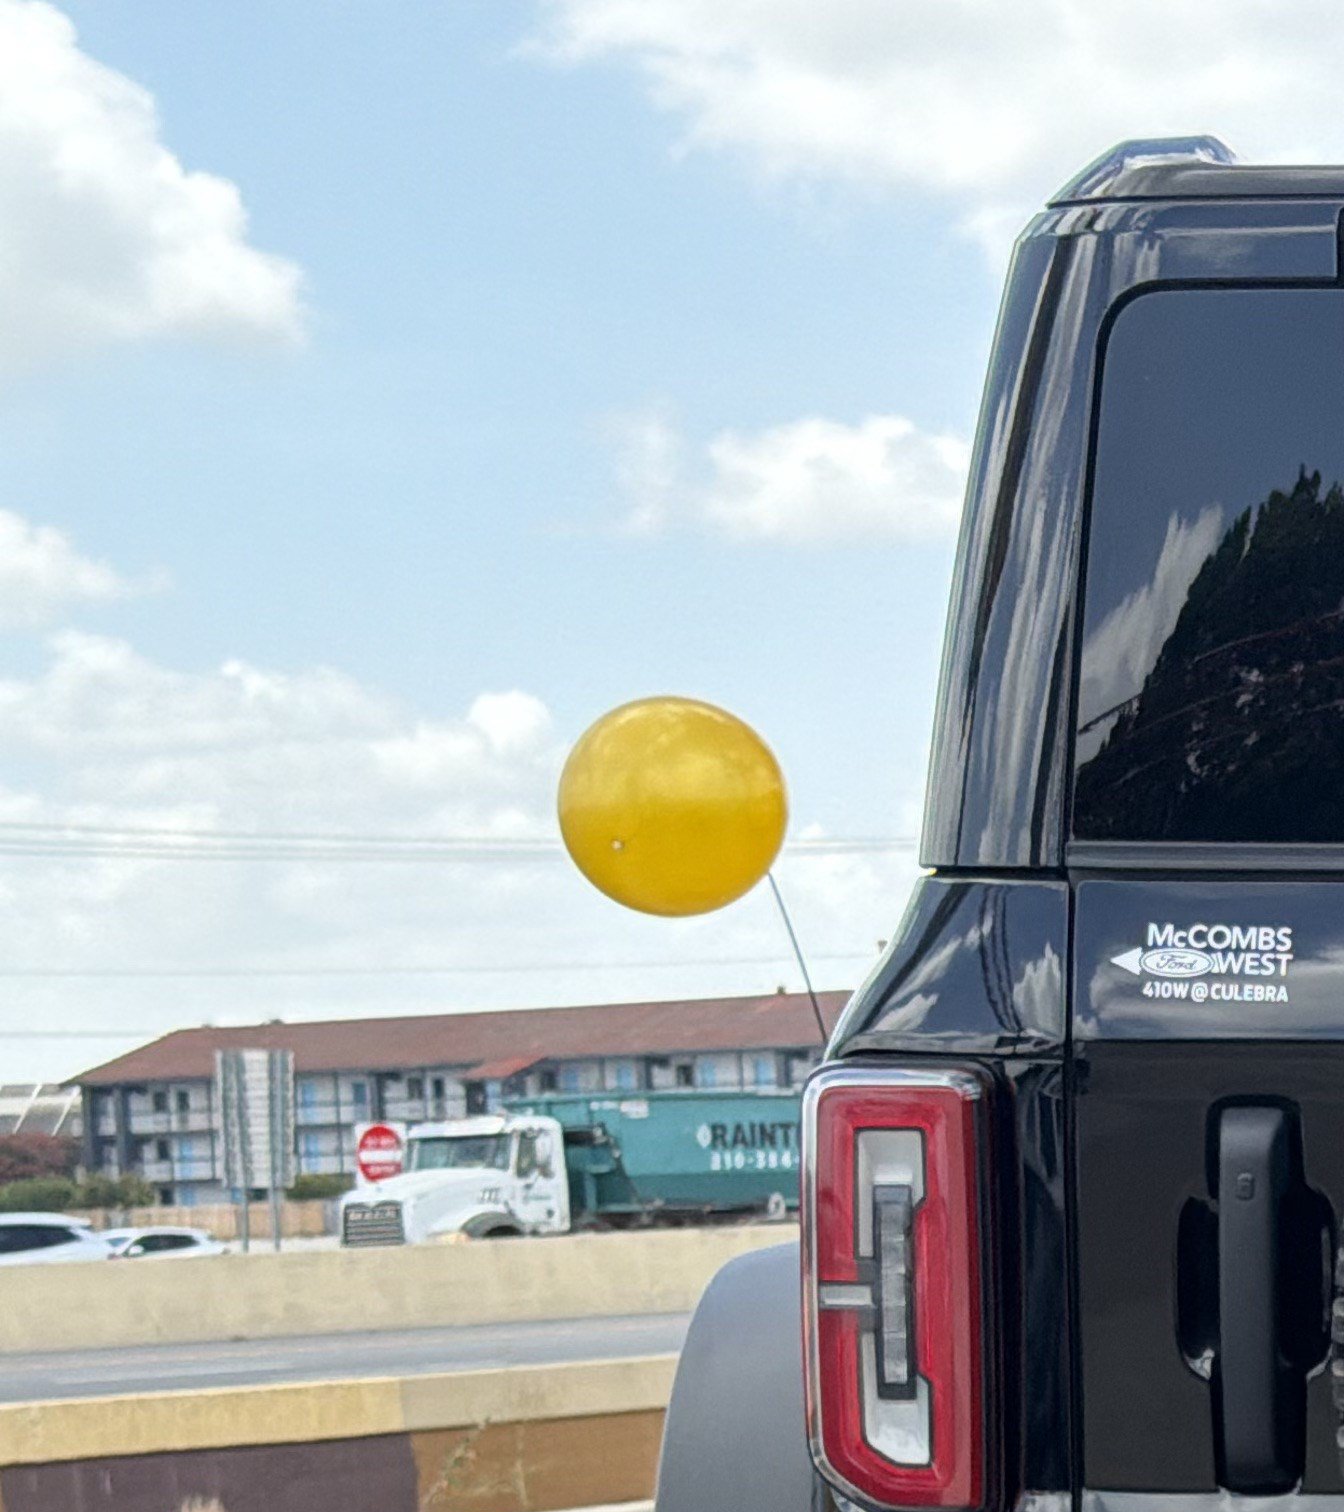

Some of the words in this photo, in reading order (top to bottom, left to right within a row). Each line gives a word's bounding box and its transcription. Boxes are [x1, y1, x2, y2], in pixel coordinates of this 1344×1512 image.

[1146, 922, 1293, 951] McCOMBS
[1156, 954, 1198, 970] Ford
[1212, 951, 1294, 977] WEST
[711, 1122, 799, 1150] RAINT
